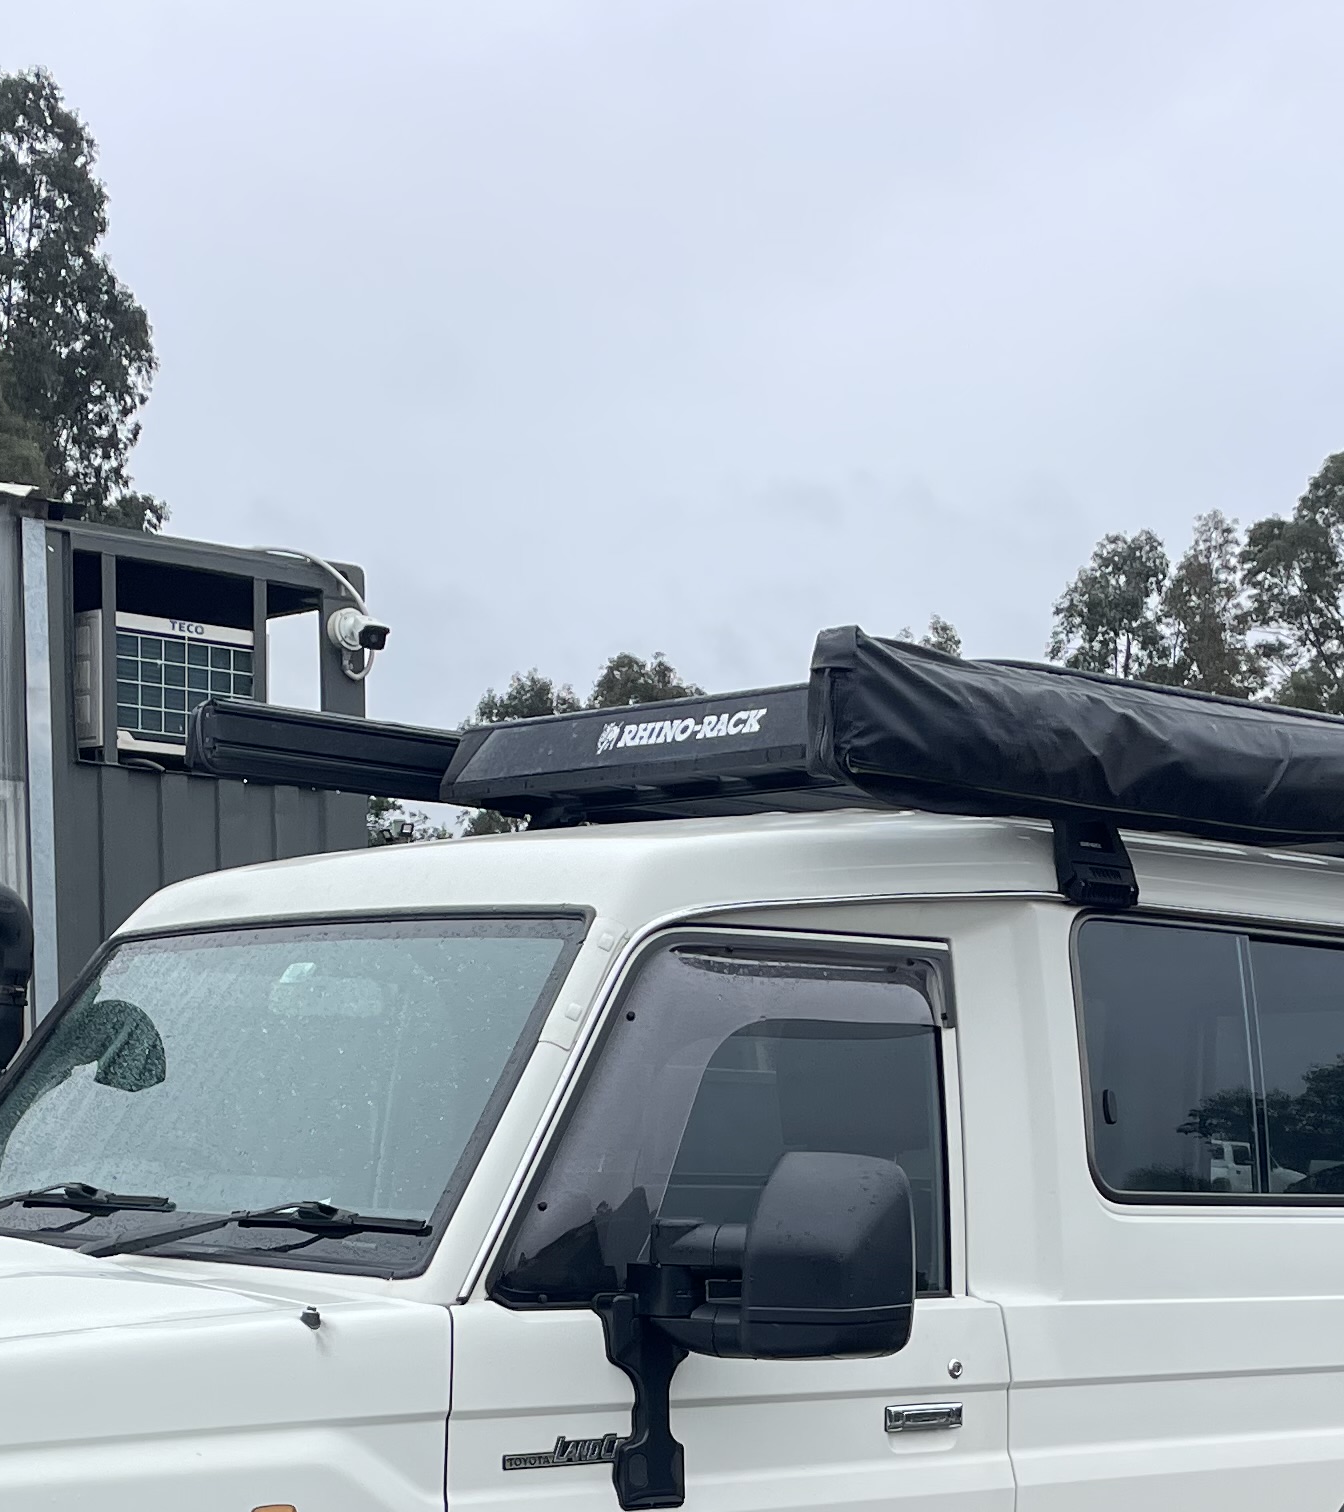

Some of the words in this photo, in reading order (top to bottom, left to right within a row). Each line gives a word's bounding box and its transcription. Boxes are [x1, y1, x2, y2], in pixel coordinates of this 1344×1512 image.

[169, 620, 205, 635] TECO
[616, 708, 768, 749] RHINO-RACK
[506, 1455, 552, 1468] TOYOTA
